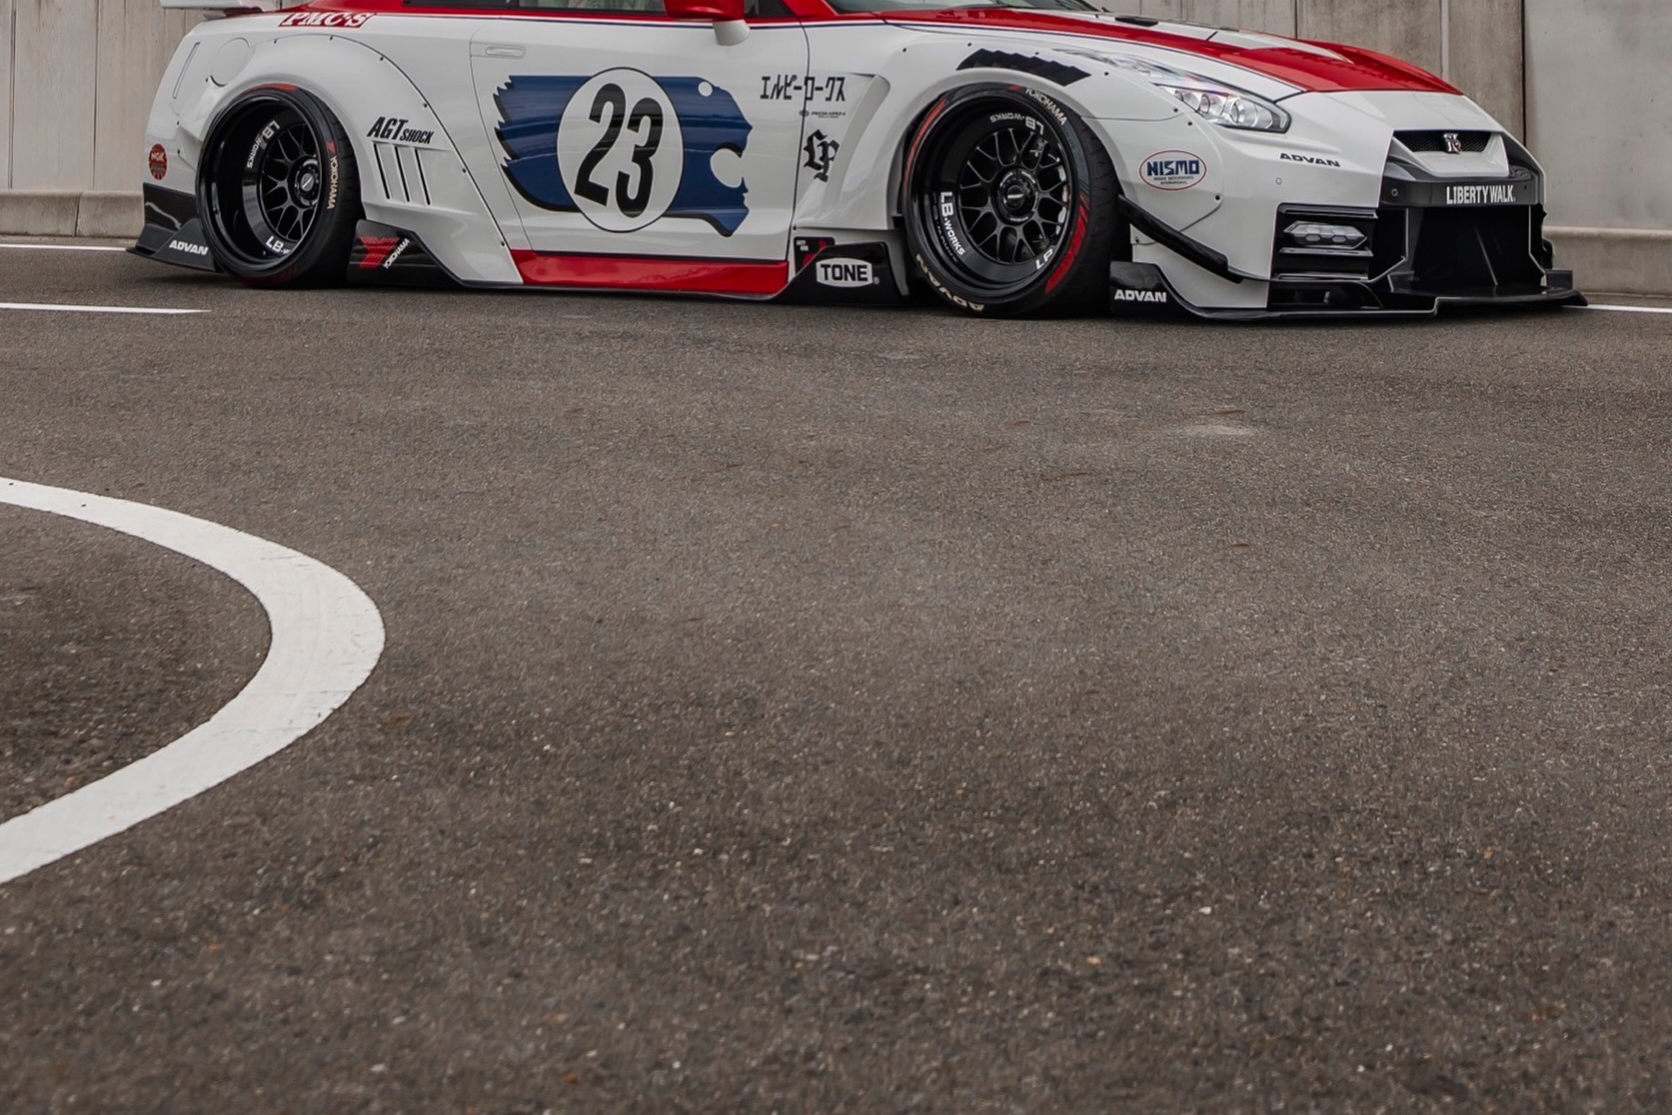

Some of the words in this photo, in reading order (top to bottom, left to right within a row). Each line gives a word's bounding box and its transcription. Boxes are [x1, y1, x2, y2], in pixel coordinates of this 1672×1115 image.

[1025, 88, 1068, 126] YOKOHAMA
[366, 116, 409, 140] AGT
[400, 128, 434, 144] SHOCK
[574, 83, 664, 219] 23
[1280, 153, 1341, 167] ADVAN
[1147, 160, 1200, 176] NISMO
[326, 156, 338, 209] YOKOHAMA
[168, 240, 209, 255] ADVAN
[383, 238, 410, 269] YOKOHAMA
[820, 264, 868, 281] TONE
[916, 254, 985, 311] ADVAN
[1114, 289, 1167, 303] ADVAN
